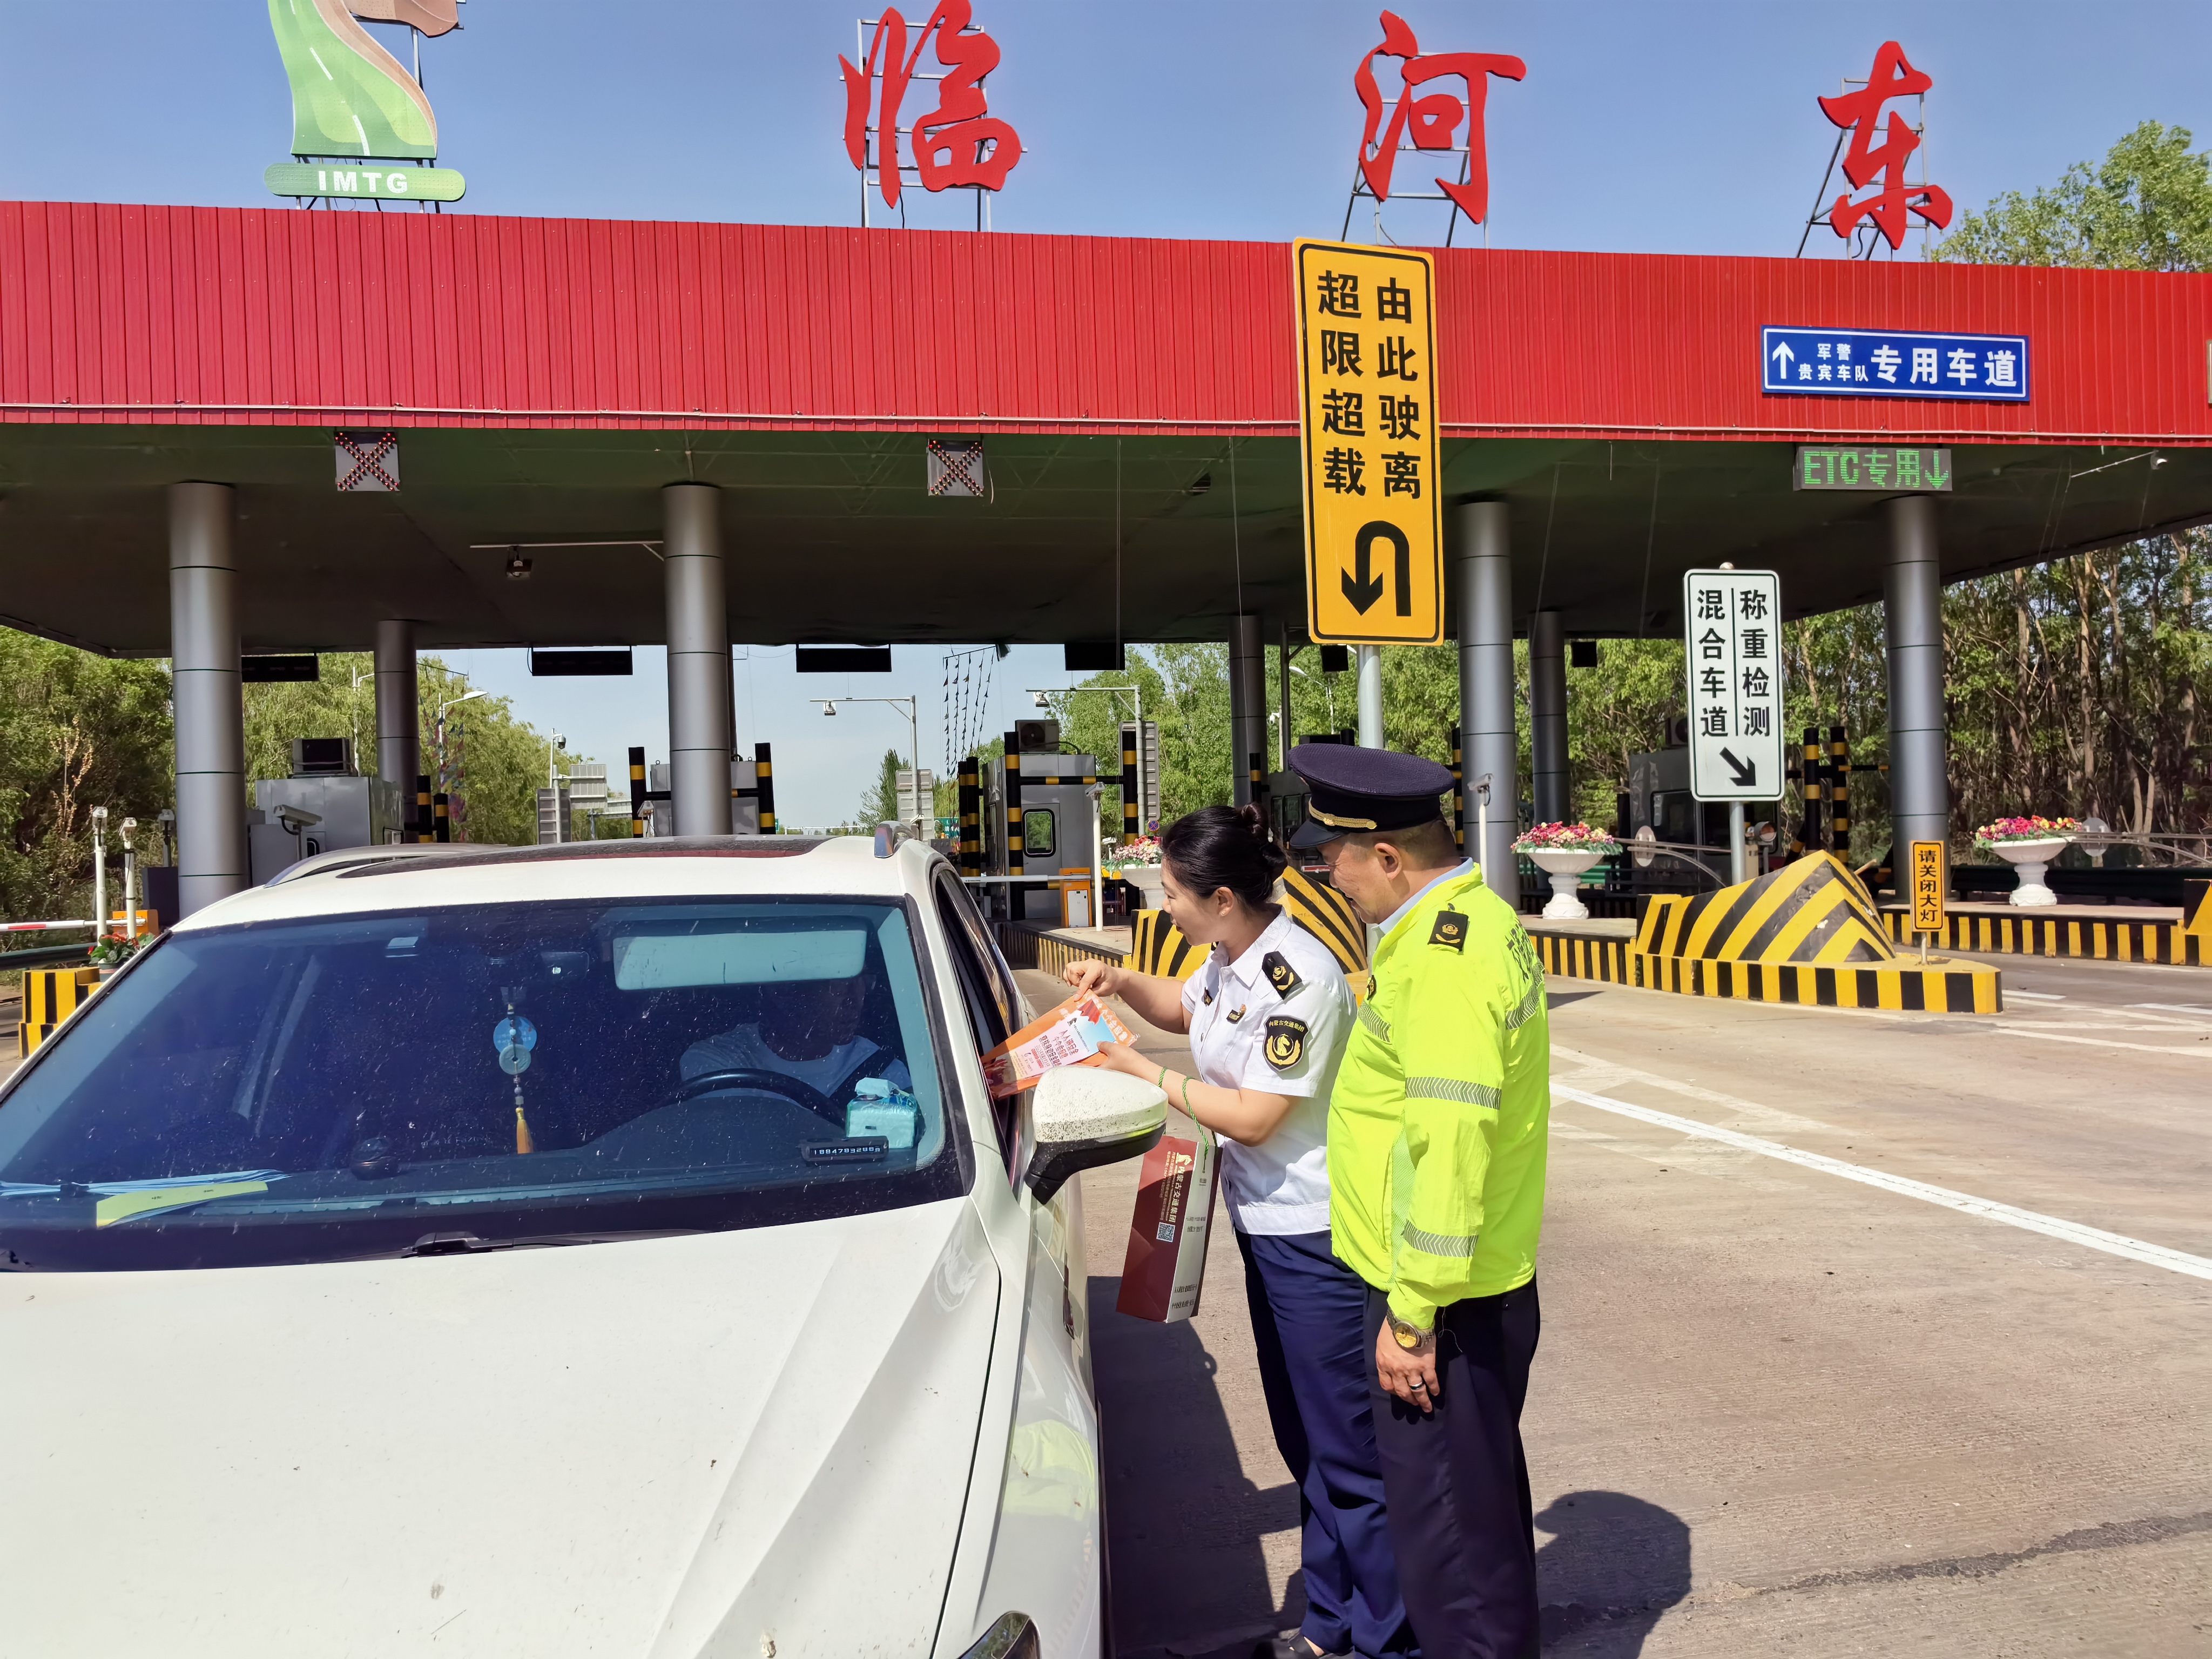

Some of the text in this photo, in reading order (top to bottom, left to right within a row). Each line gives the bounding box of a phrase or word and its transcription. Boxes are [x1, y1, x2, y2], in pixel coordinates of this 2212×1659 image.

[319, 171, 408, 194] IMTG
[1317, 269, 1366, 497] 超限超载
[1798, 363, 1869, 382] 贵宾车队
[1817, 343, 1851, 361] 军警
[1871, 344, 2018, 387] 专用车道
[1377, 276, 1421, 500] 由此驶离
[1697, 589, 1728, 738] 混合车道
[1739, 589, 1770, 737] 称重检测
[1919, 849, 1938, 922] 请关闭大灯
[1169, 1165, 1185, 1223] 内蒙古交通集团
